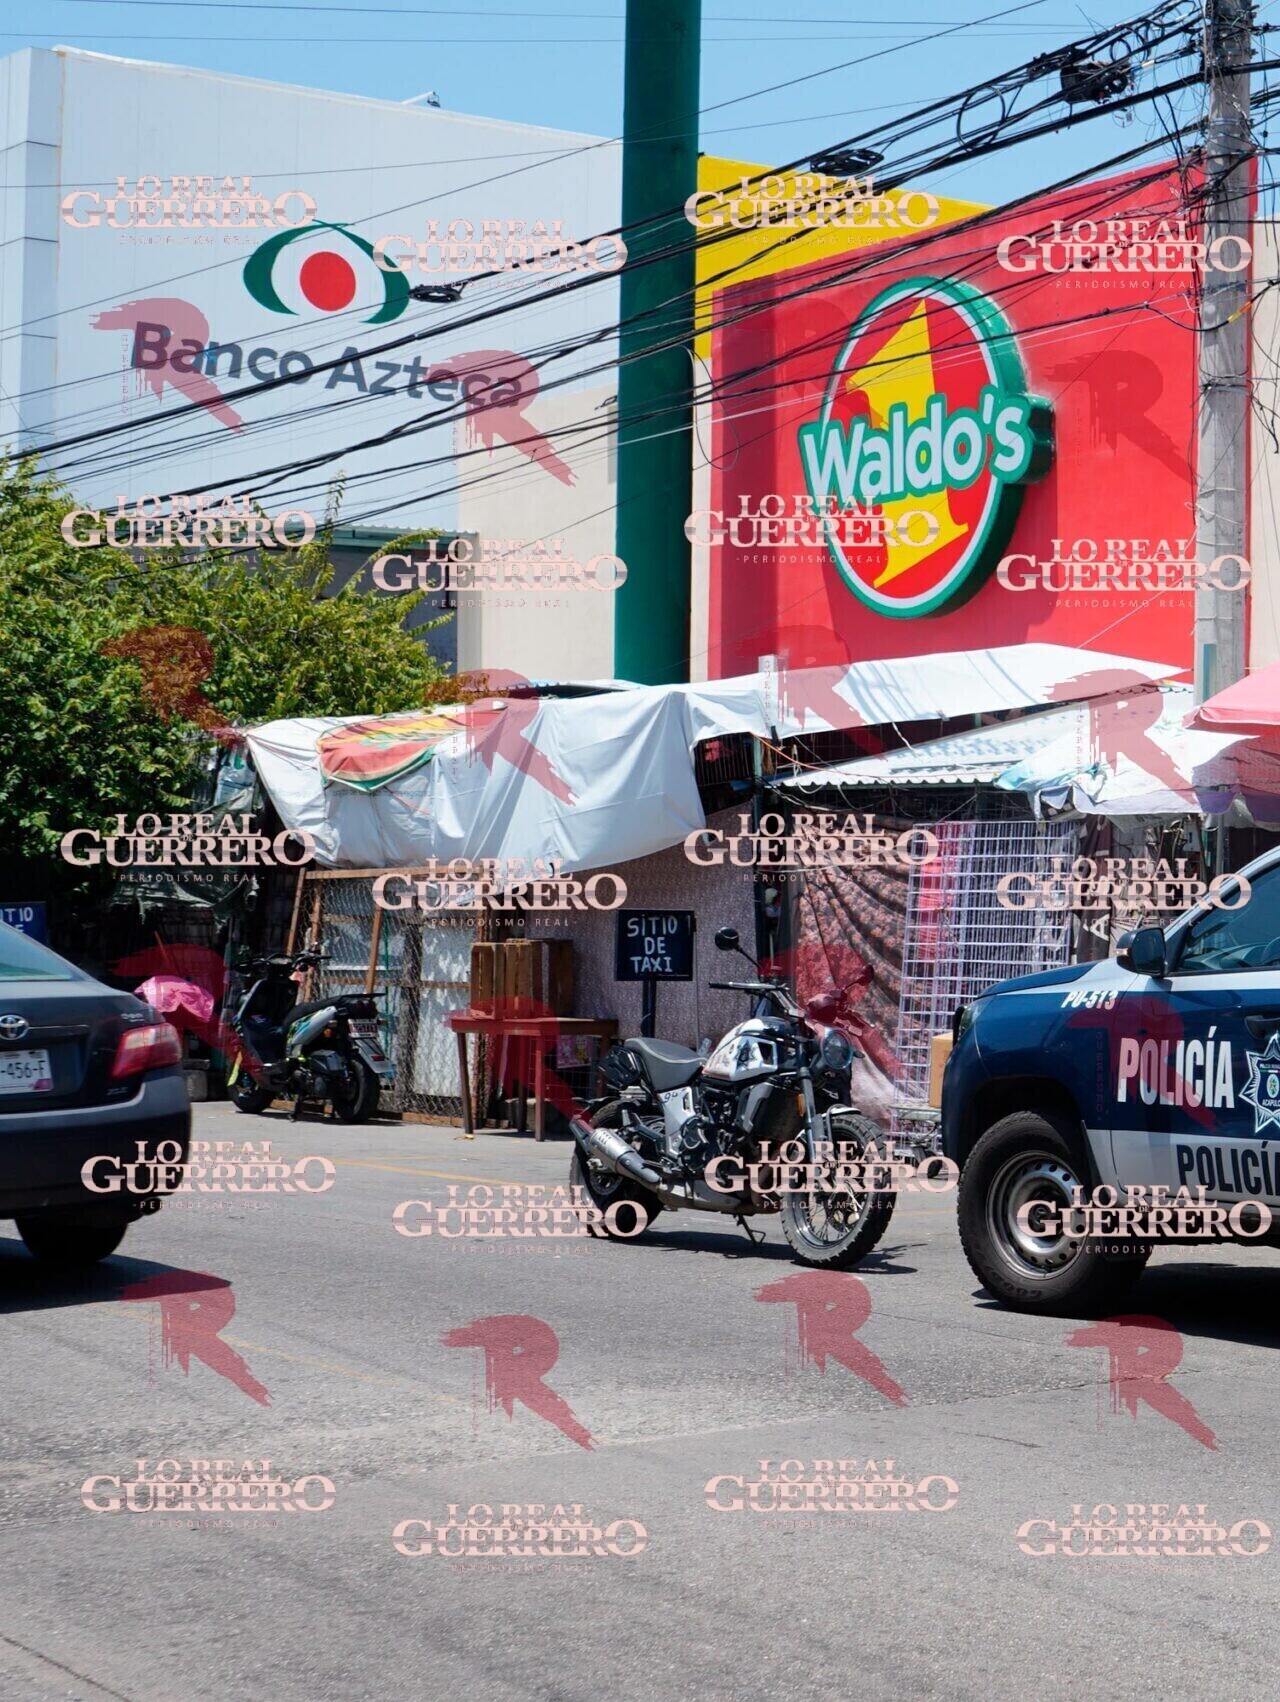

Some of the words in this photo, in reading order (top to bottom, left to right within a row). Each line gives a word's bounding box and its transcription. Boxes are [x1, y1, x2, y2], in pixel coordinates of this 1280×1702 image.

[131, 321, 313, 385] Banco
[325, 345, 523, 409] Azteca
[803, 393, 1026, 509] Waldo's
[630, 956, 673, 974] TAXI
[644, 936, 666, 955] DE
[1061, 990, 1119, 1010] PU-513
[1117, 1025, 1235, 1109] POLICÍA
